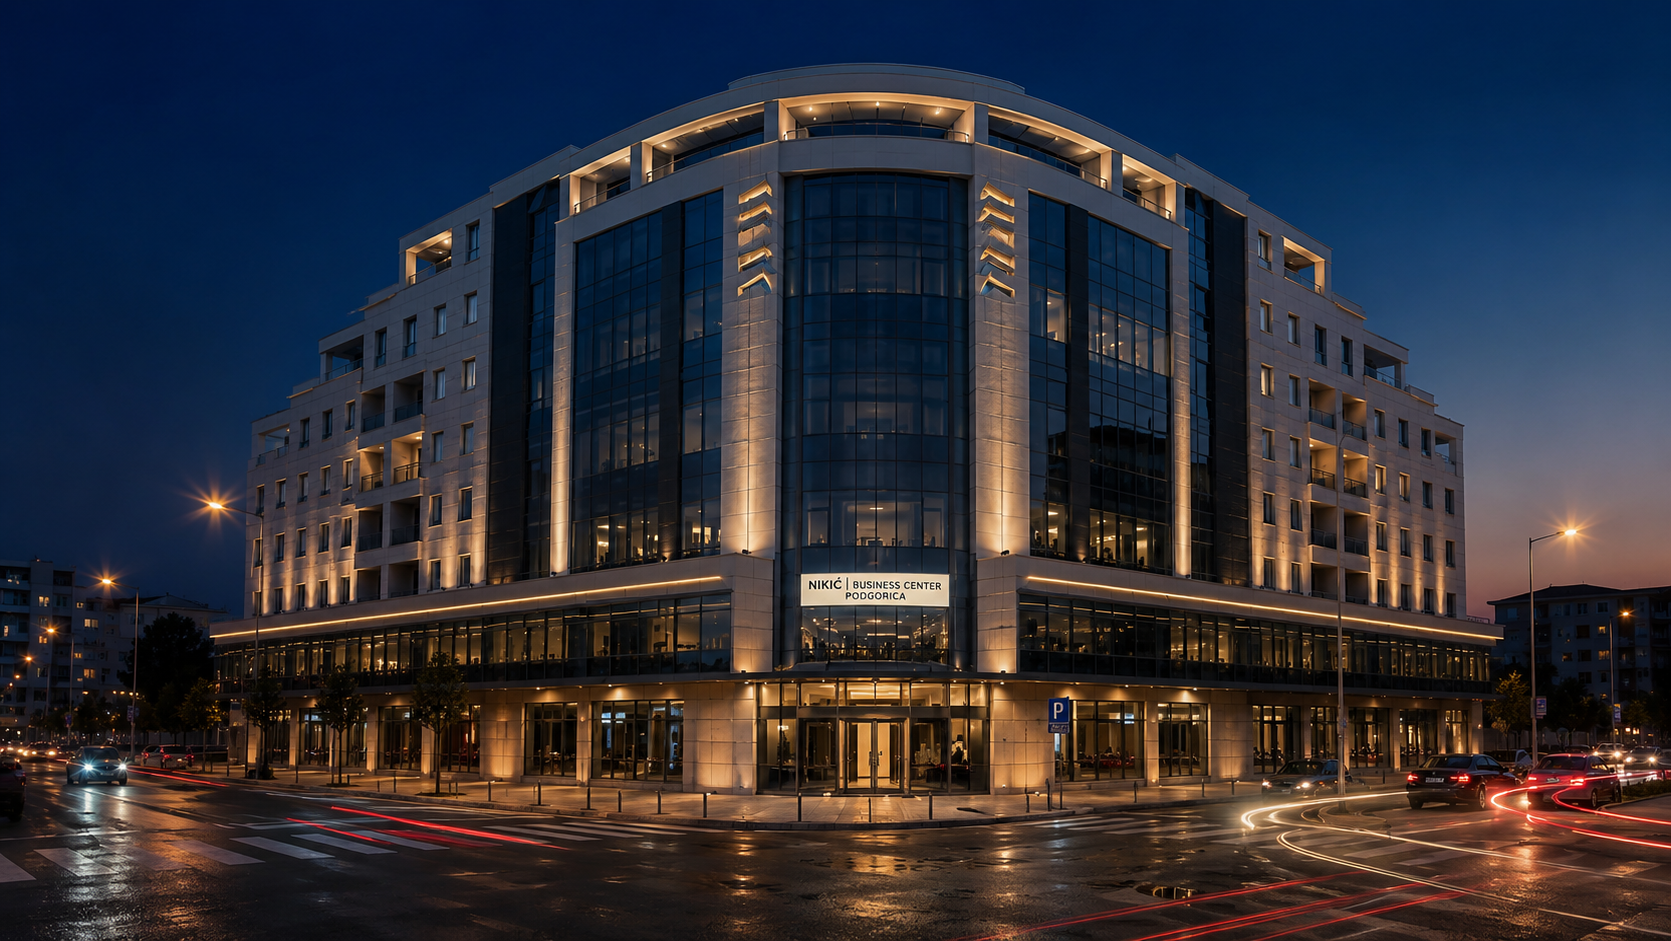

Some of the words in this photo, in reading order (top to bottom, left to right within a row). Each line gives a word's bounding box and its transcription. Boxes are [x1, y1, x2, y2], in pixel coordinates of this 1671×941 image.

[808, 577, 842, 590] NIKIĆ
[852, 580, 901, 590] BUSINESS
[903, 581, 942, 591] CENTER
[845, 591, 906, 601] PODGORICA
[1053, 702, 1064, 719] P
